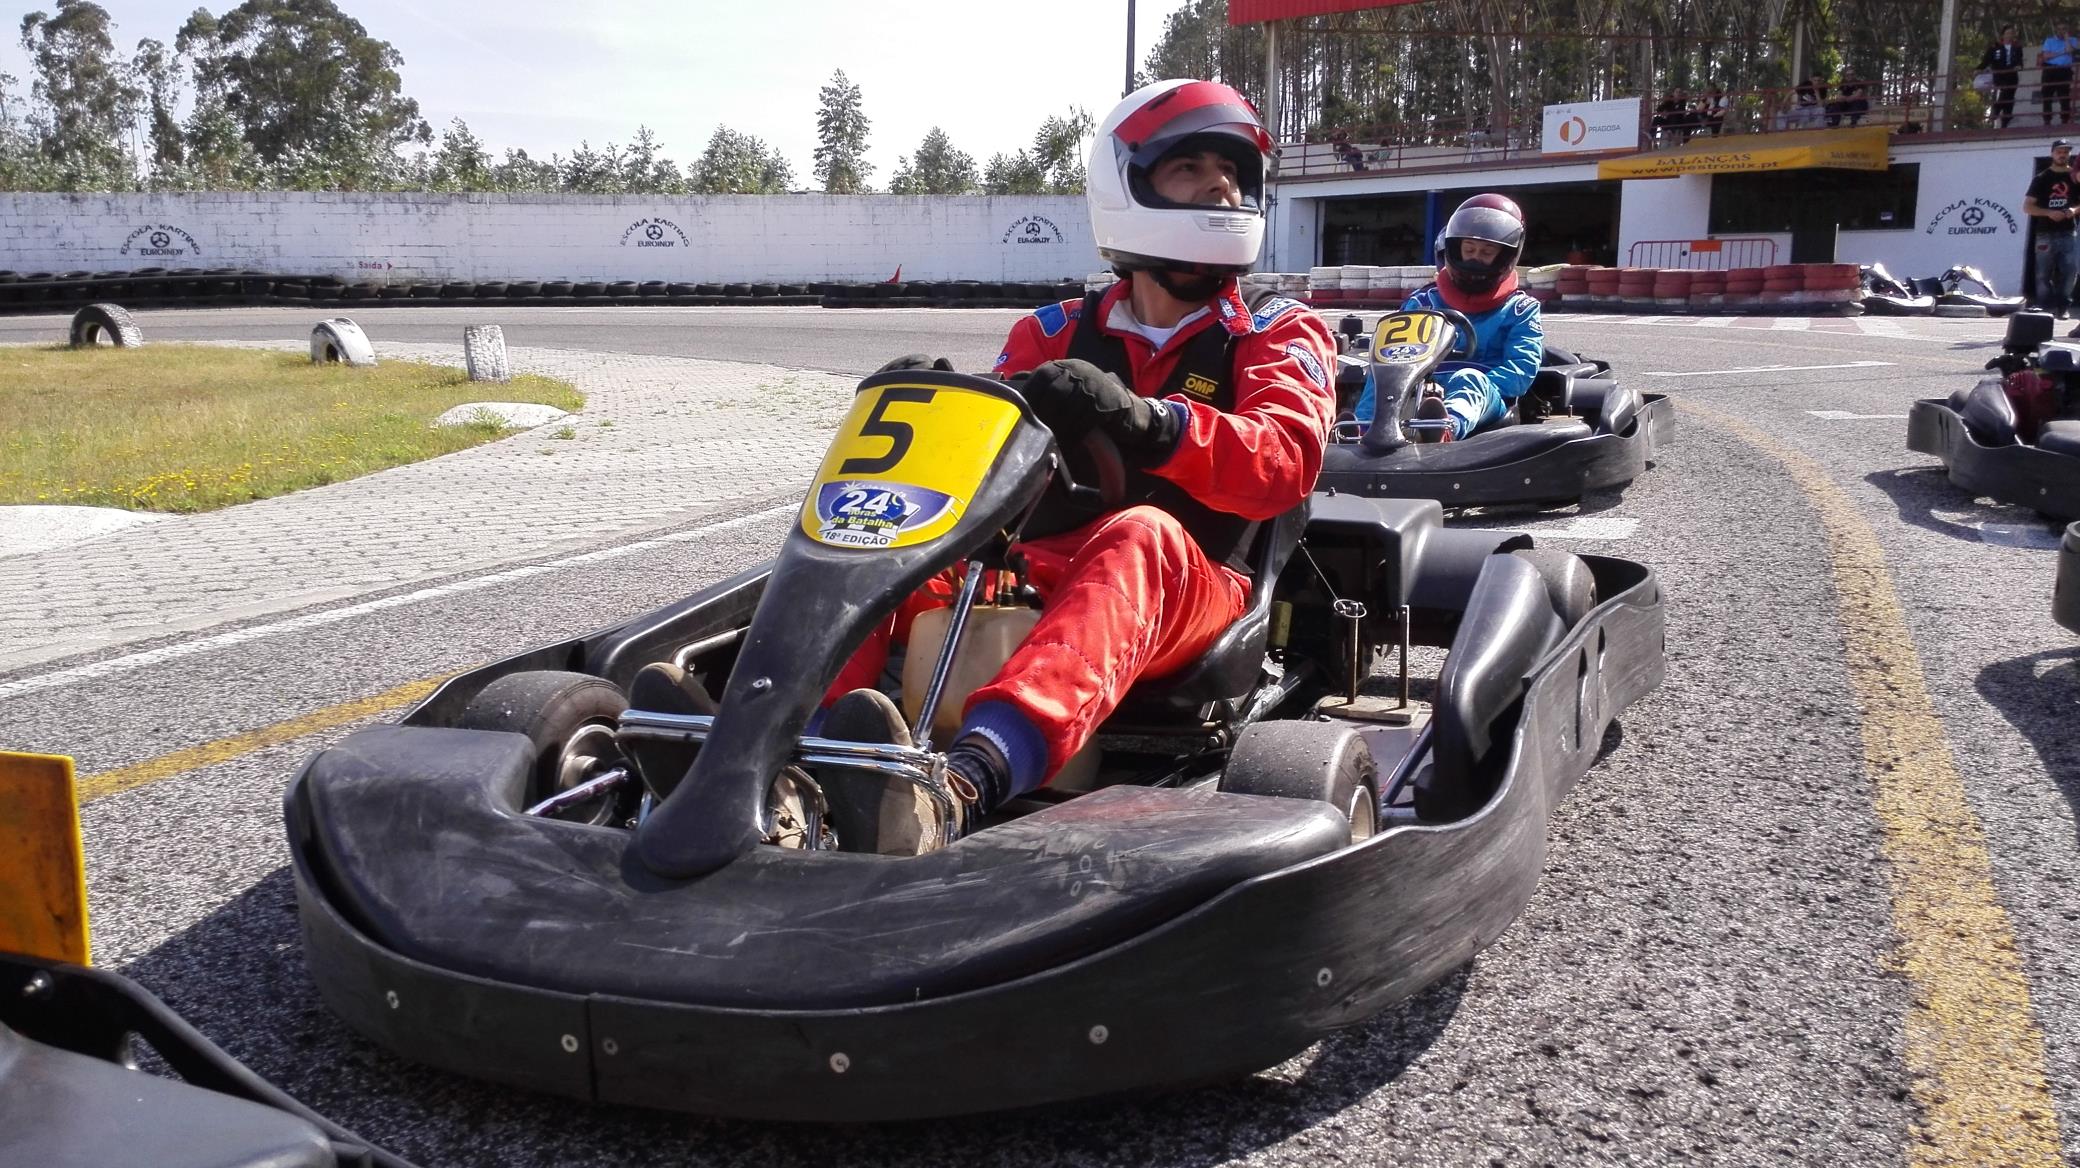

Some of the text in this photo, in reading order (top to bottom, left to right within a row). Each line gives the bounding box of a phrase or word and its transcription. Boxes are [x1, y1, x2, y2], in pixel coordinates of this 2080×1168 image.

[1588, 124, 1621, 133] PRAGOSA
[1926, 198, 2018, 235] ESCOLA KARTING
[120, 224, 201, 255] ESCOLA KARTING
[620, 217, 690, 247] ESCOLA KARTING
[1948, 226, 1998, 235] EUROINDY
[141, 248, 184, 256] EUROINDY
[1384, 315, 1438, 345] 20
[1185, 377, 1216, 395] OMP
[838, 387, 938, 475] 5
[839, 490, 891, 515] 24
[831, 516, 894, 529] da Batalha
[842, 534, 889, 546] EDIÇÃO
